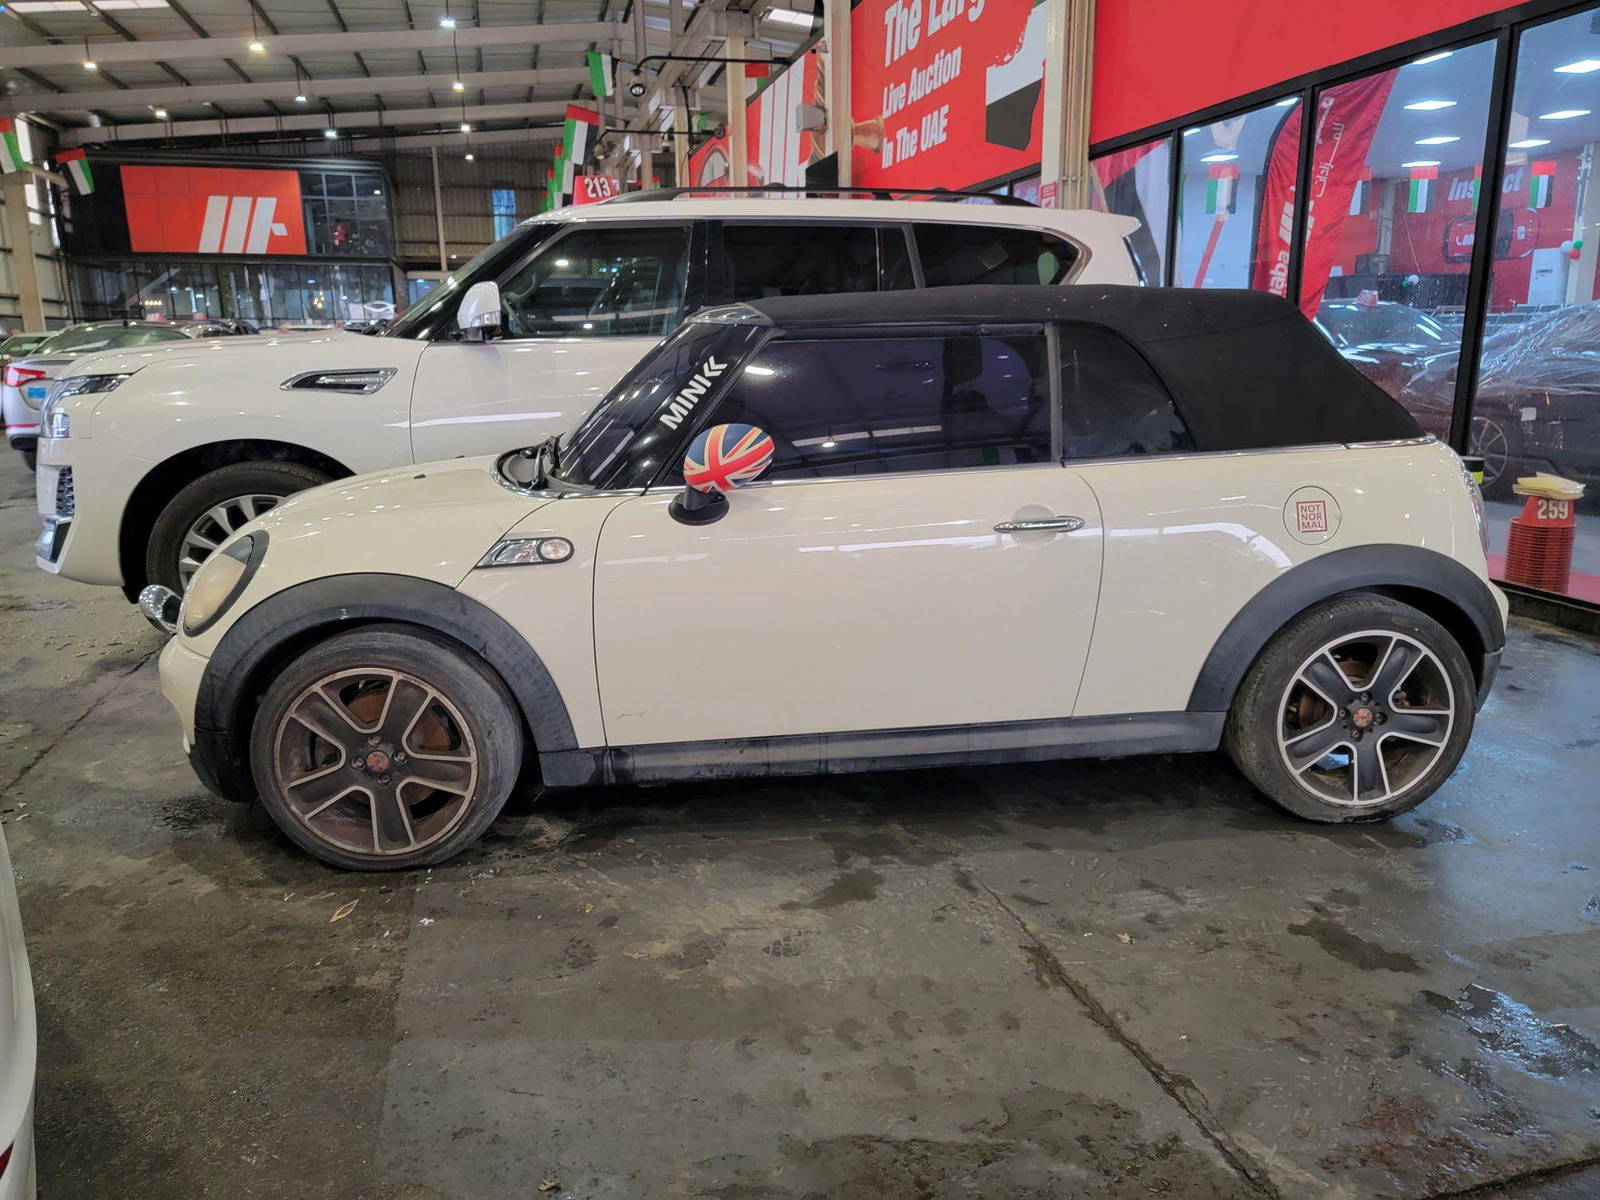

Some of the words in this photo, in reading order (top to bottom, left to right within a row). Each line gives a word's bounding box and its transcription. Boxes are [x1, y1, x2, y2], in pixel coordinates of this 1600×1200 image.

[884, 0, 922, 68] The
[882, 81, 907, 119] Live
[907, 45, 963, 105] Auction
[881, 137, 894, 169] In
[896, 126, 918, 163] The
[920, 104, 950, 152] UAE
[584, 177, 611, 198] 213
[1448, 167, 1524, 201] Insct
[1300, 504, 1321, 513] NOT
[1301, 513, 1323, 521] NOR
[1537, 499, 1569, 520] 259
[1301, 521, 1324, 529] MAL
